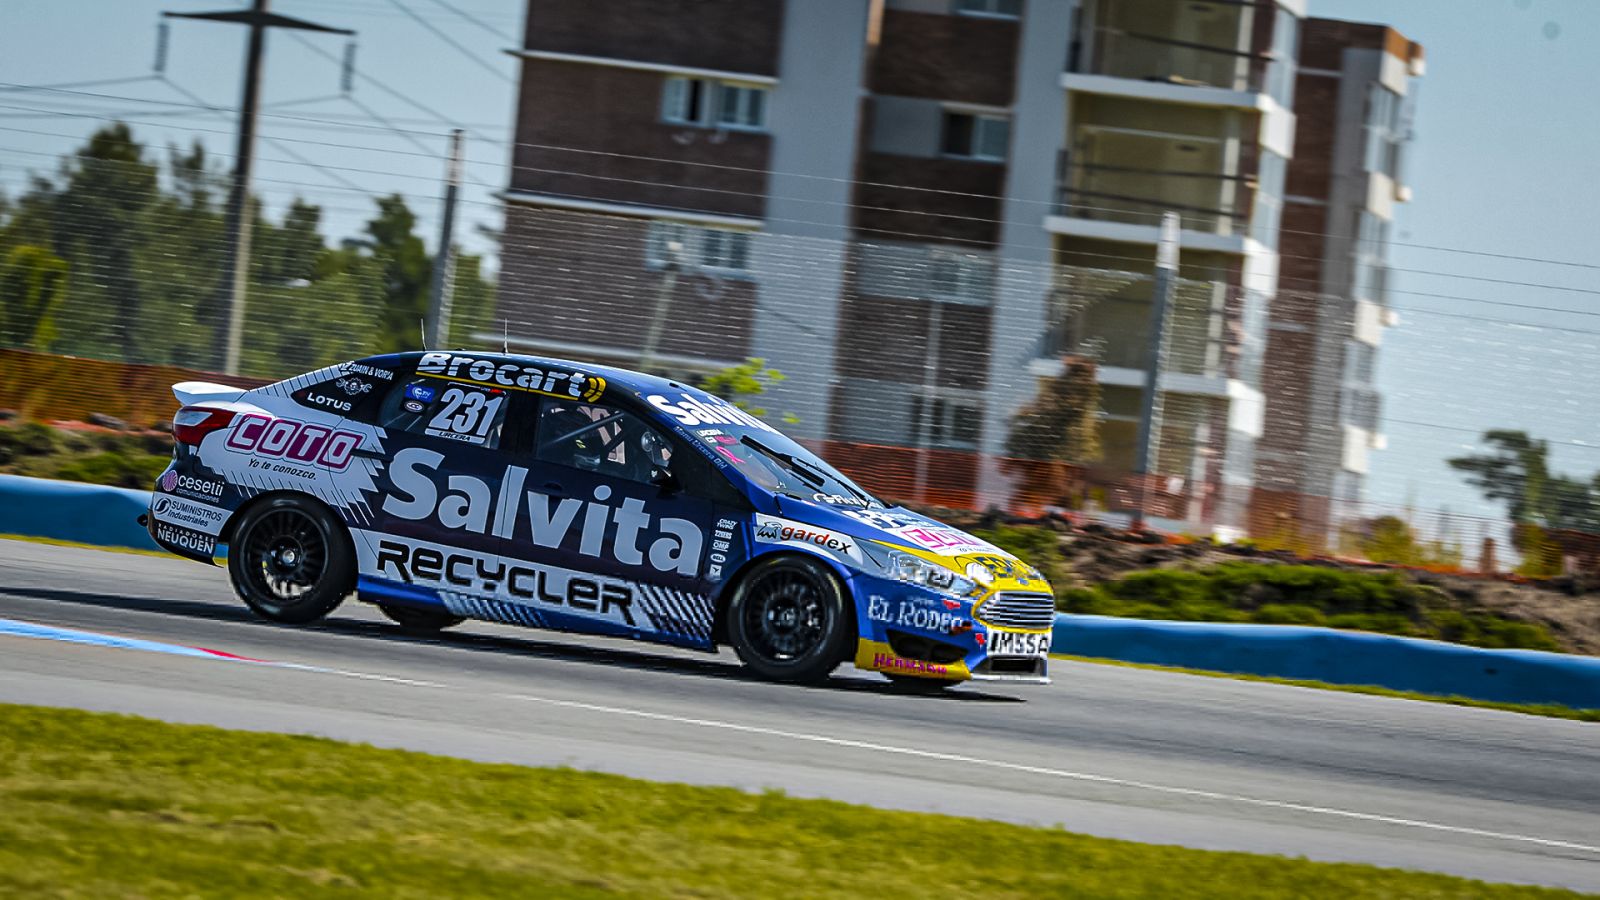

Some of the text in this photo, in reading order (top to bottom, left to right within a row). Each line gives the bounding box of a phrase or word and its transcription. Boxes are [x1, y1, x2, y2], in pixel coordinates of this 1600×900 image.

[417, 353, 586, 397] Brocart
[307, 392, 352, 411] LOTUS
[428, 388, 504, 436] 231
[226, 413, 364, 470] COTO
[248, 458, 256, 467] Yo
[261, 461, 270, 470] te
[172, 501, 223, 521] SUMINISTROS
[382, 447, 703, 576] Salvita
[157, 528, 214, 554] NEUQUEN
[780, 526, 852, 555] gardex
